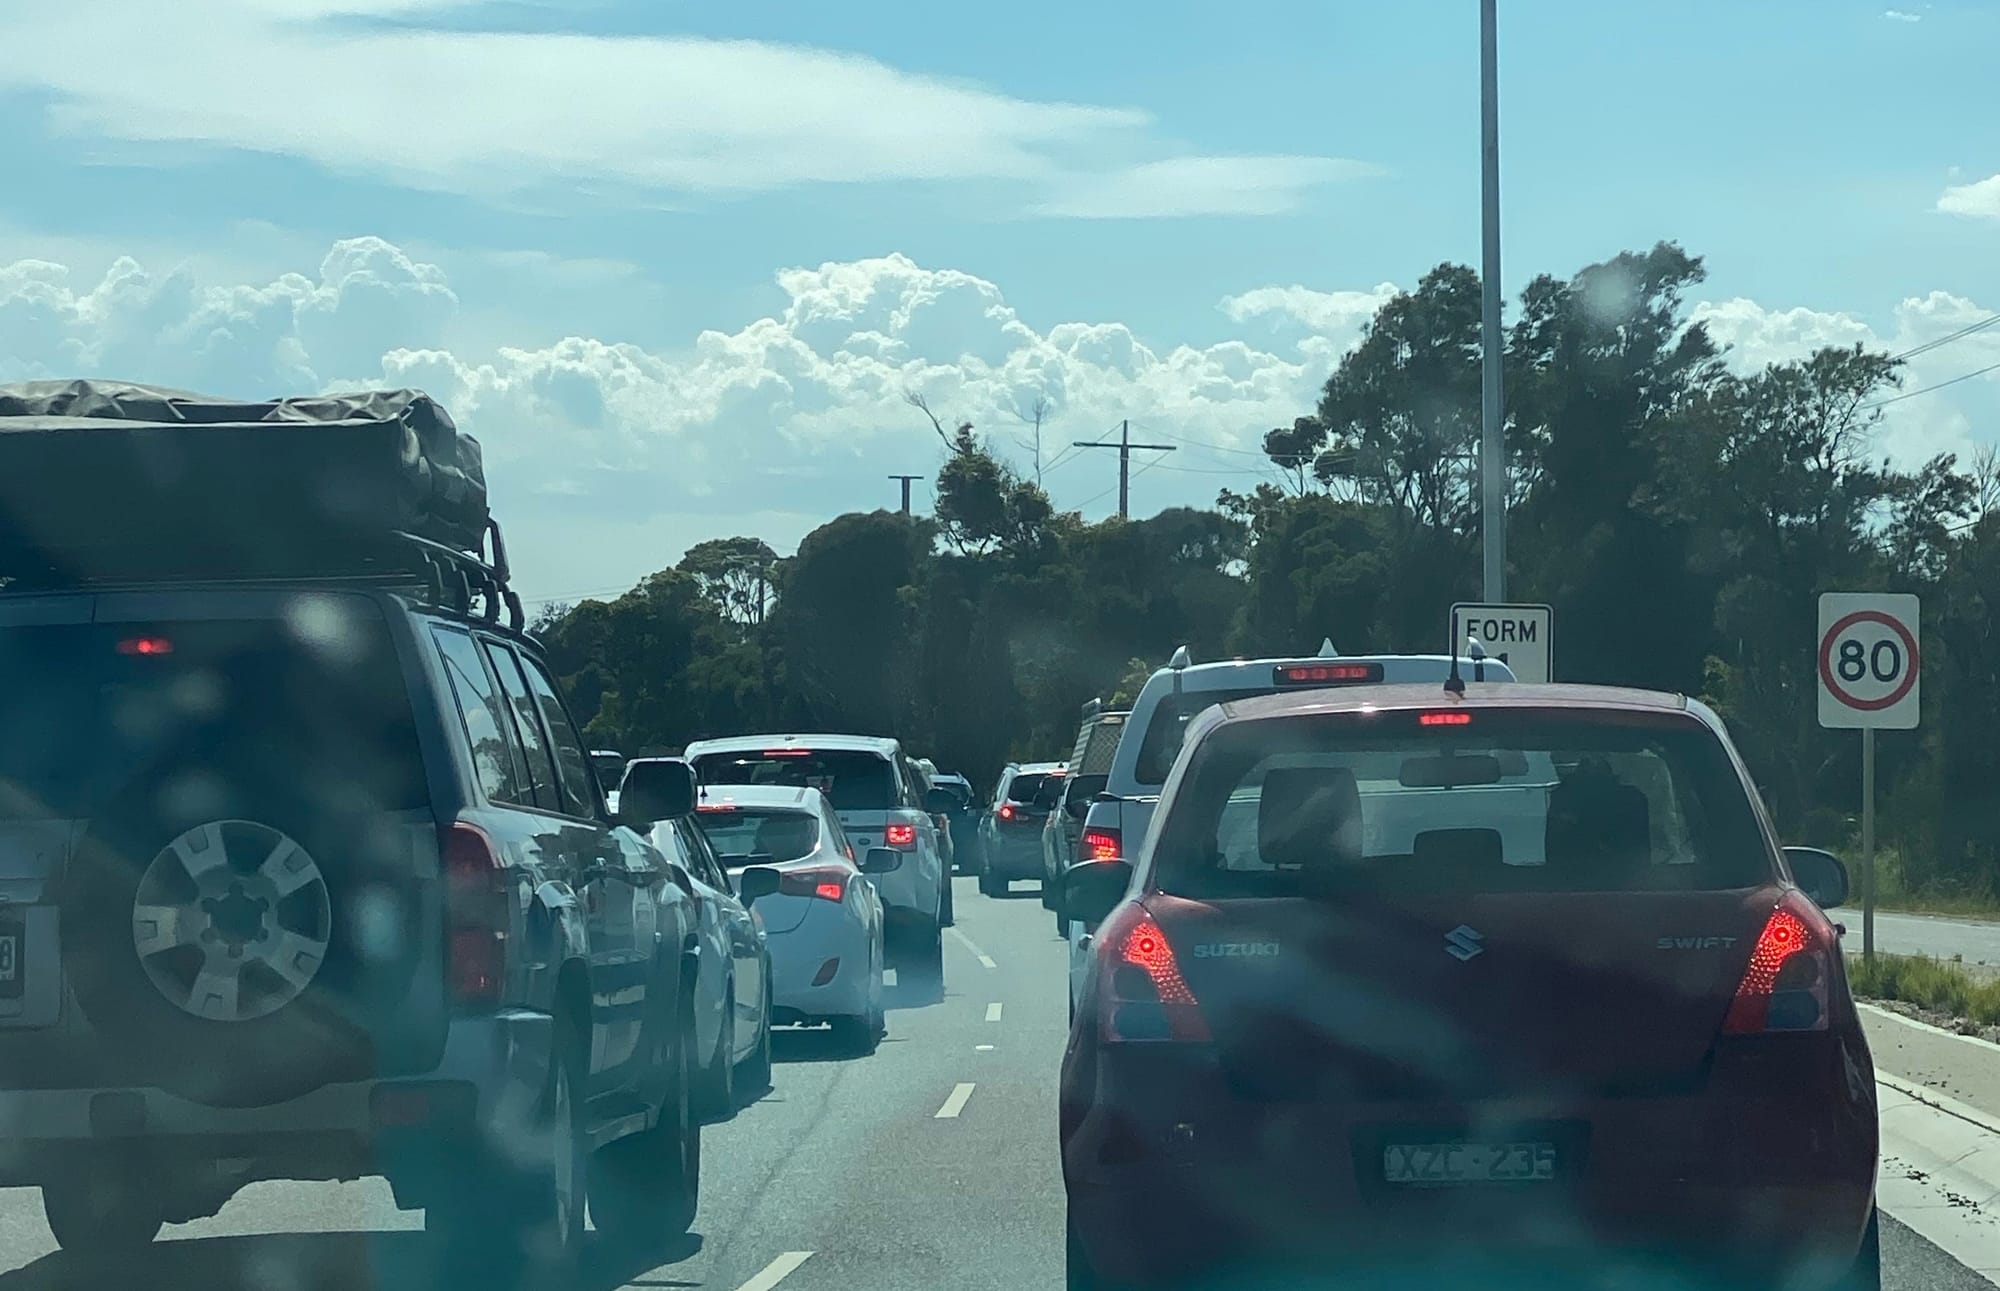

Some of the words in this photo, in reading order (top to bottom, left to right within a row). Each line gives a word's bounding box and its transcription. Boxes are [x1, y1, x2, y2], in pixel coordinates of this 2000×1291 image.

[1467, 619, 1536, 642] FORM
[1838, 639, 1900, 682] 80
[1193, 943, 1280, 958] SUZUKI
[1656, 936, 1737, 949] SWIFT
